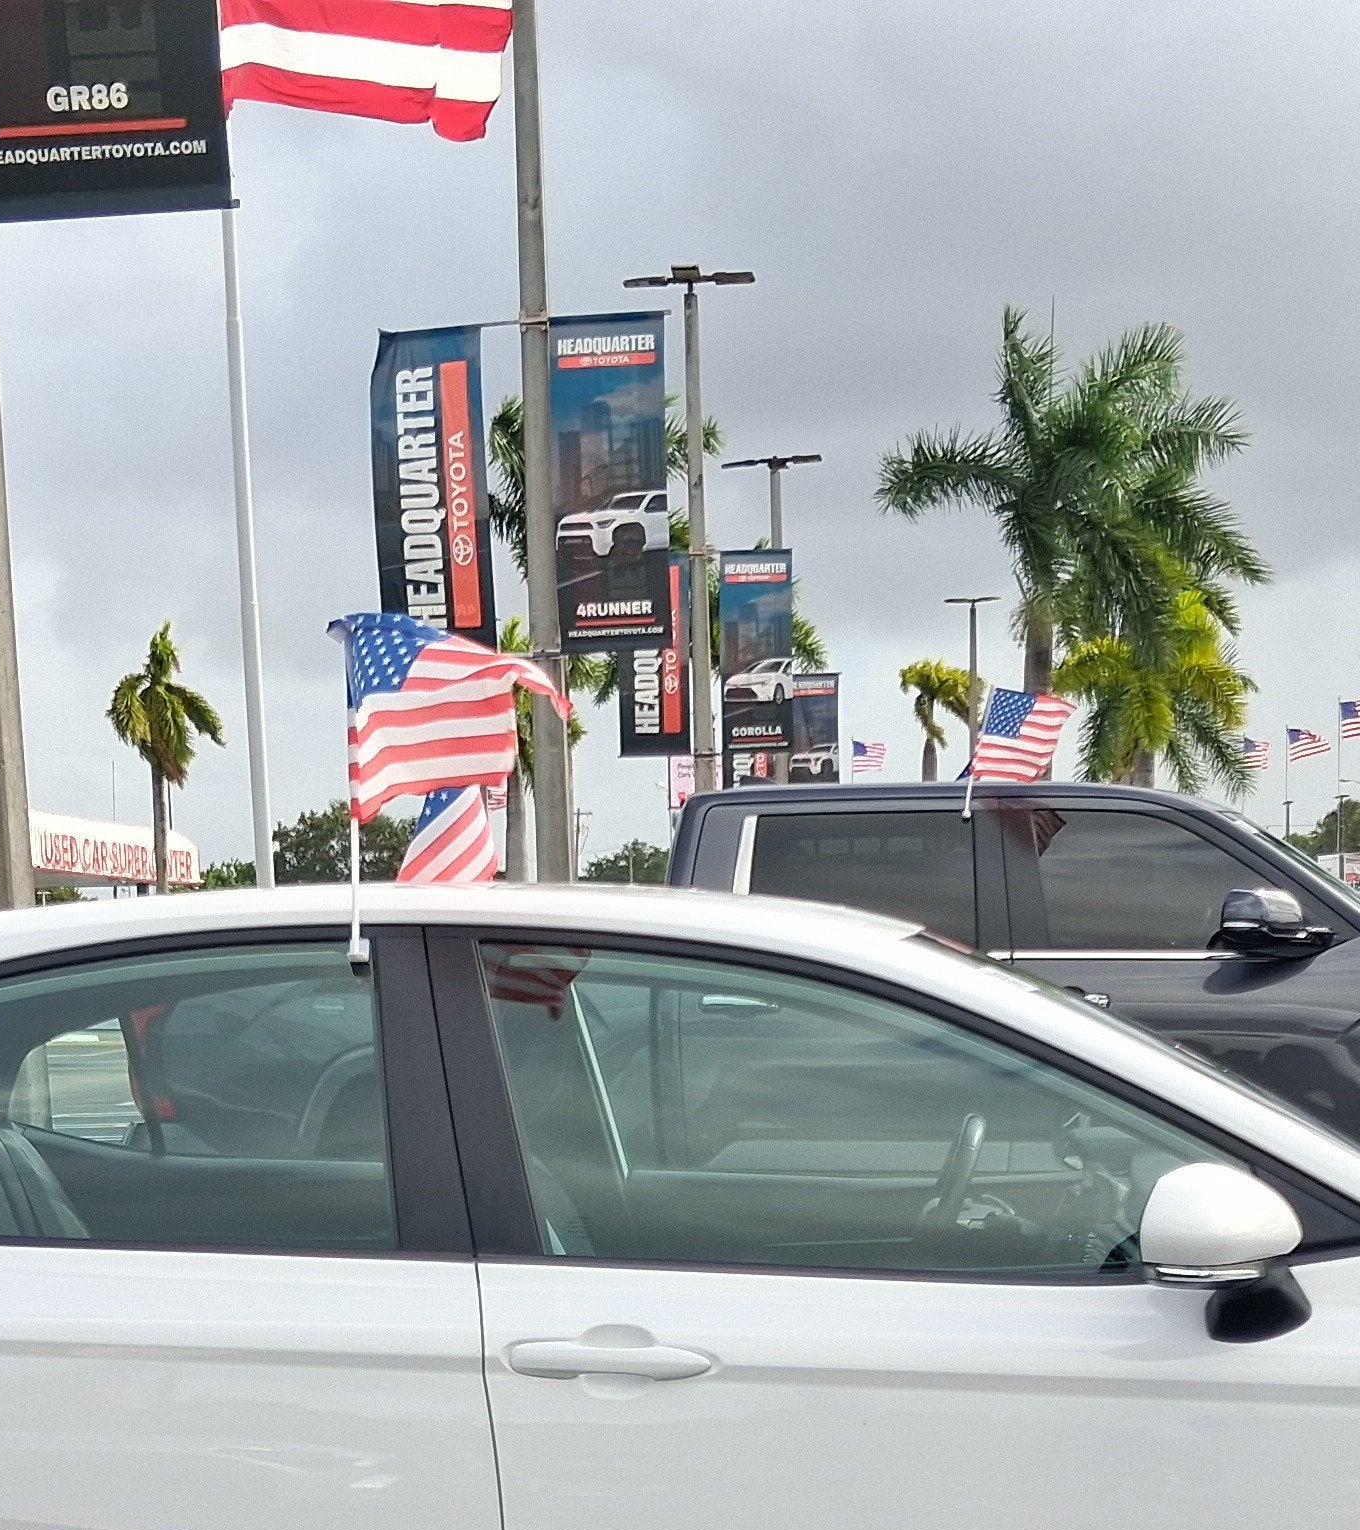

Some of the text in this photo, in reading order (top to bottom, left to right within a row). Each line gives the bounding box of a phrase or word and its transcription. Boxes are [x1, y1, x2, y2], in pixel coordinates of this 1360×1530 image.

[46, 82, 129, 112] GR86
[557, 334, 655, 356] HEADQUARTER
[593, 355, 630, 365] TOYOTA
[448, 430, 470, 532] TOYOTA
[395, 366, 448, 629] HEADQUARTER
[576, 601, 653, 618] 4RUNNER
[41, 831, 192, 880] USED CAR SUPER CNTER
